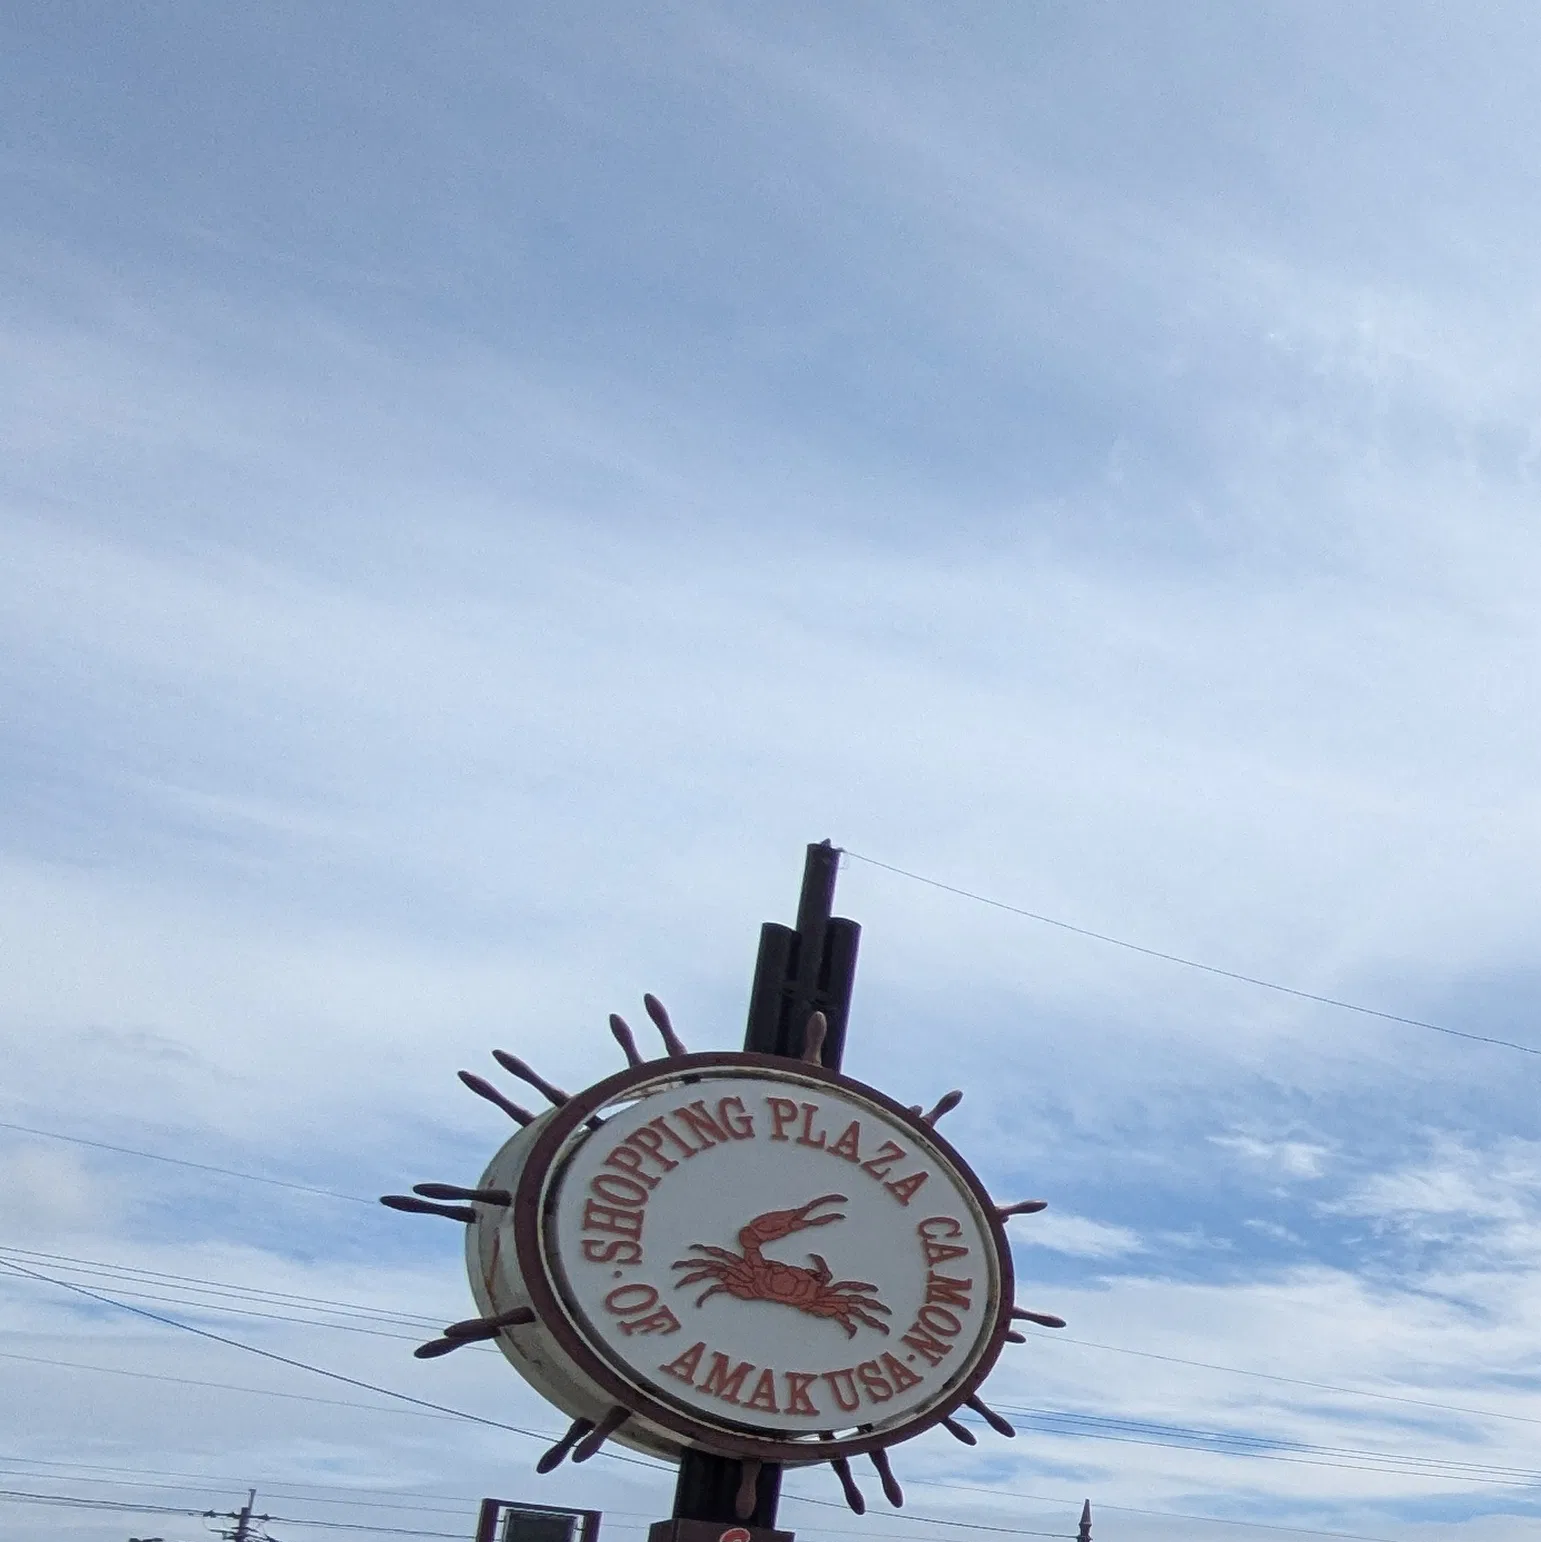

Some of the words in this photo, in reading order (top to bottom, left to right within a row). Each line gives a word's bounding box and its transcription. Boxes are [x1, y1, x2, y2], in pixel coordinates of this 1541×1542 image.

[581, 1096, 756, 1268] SHOPPING
[766, 1096, 930, 1207] PLAZA
[901, 1215, 974, 1367] CAMON
[605, 1282, 682, 1337] OF
[660, 1341, 923, 1417] AMAKUSA
